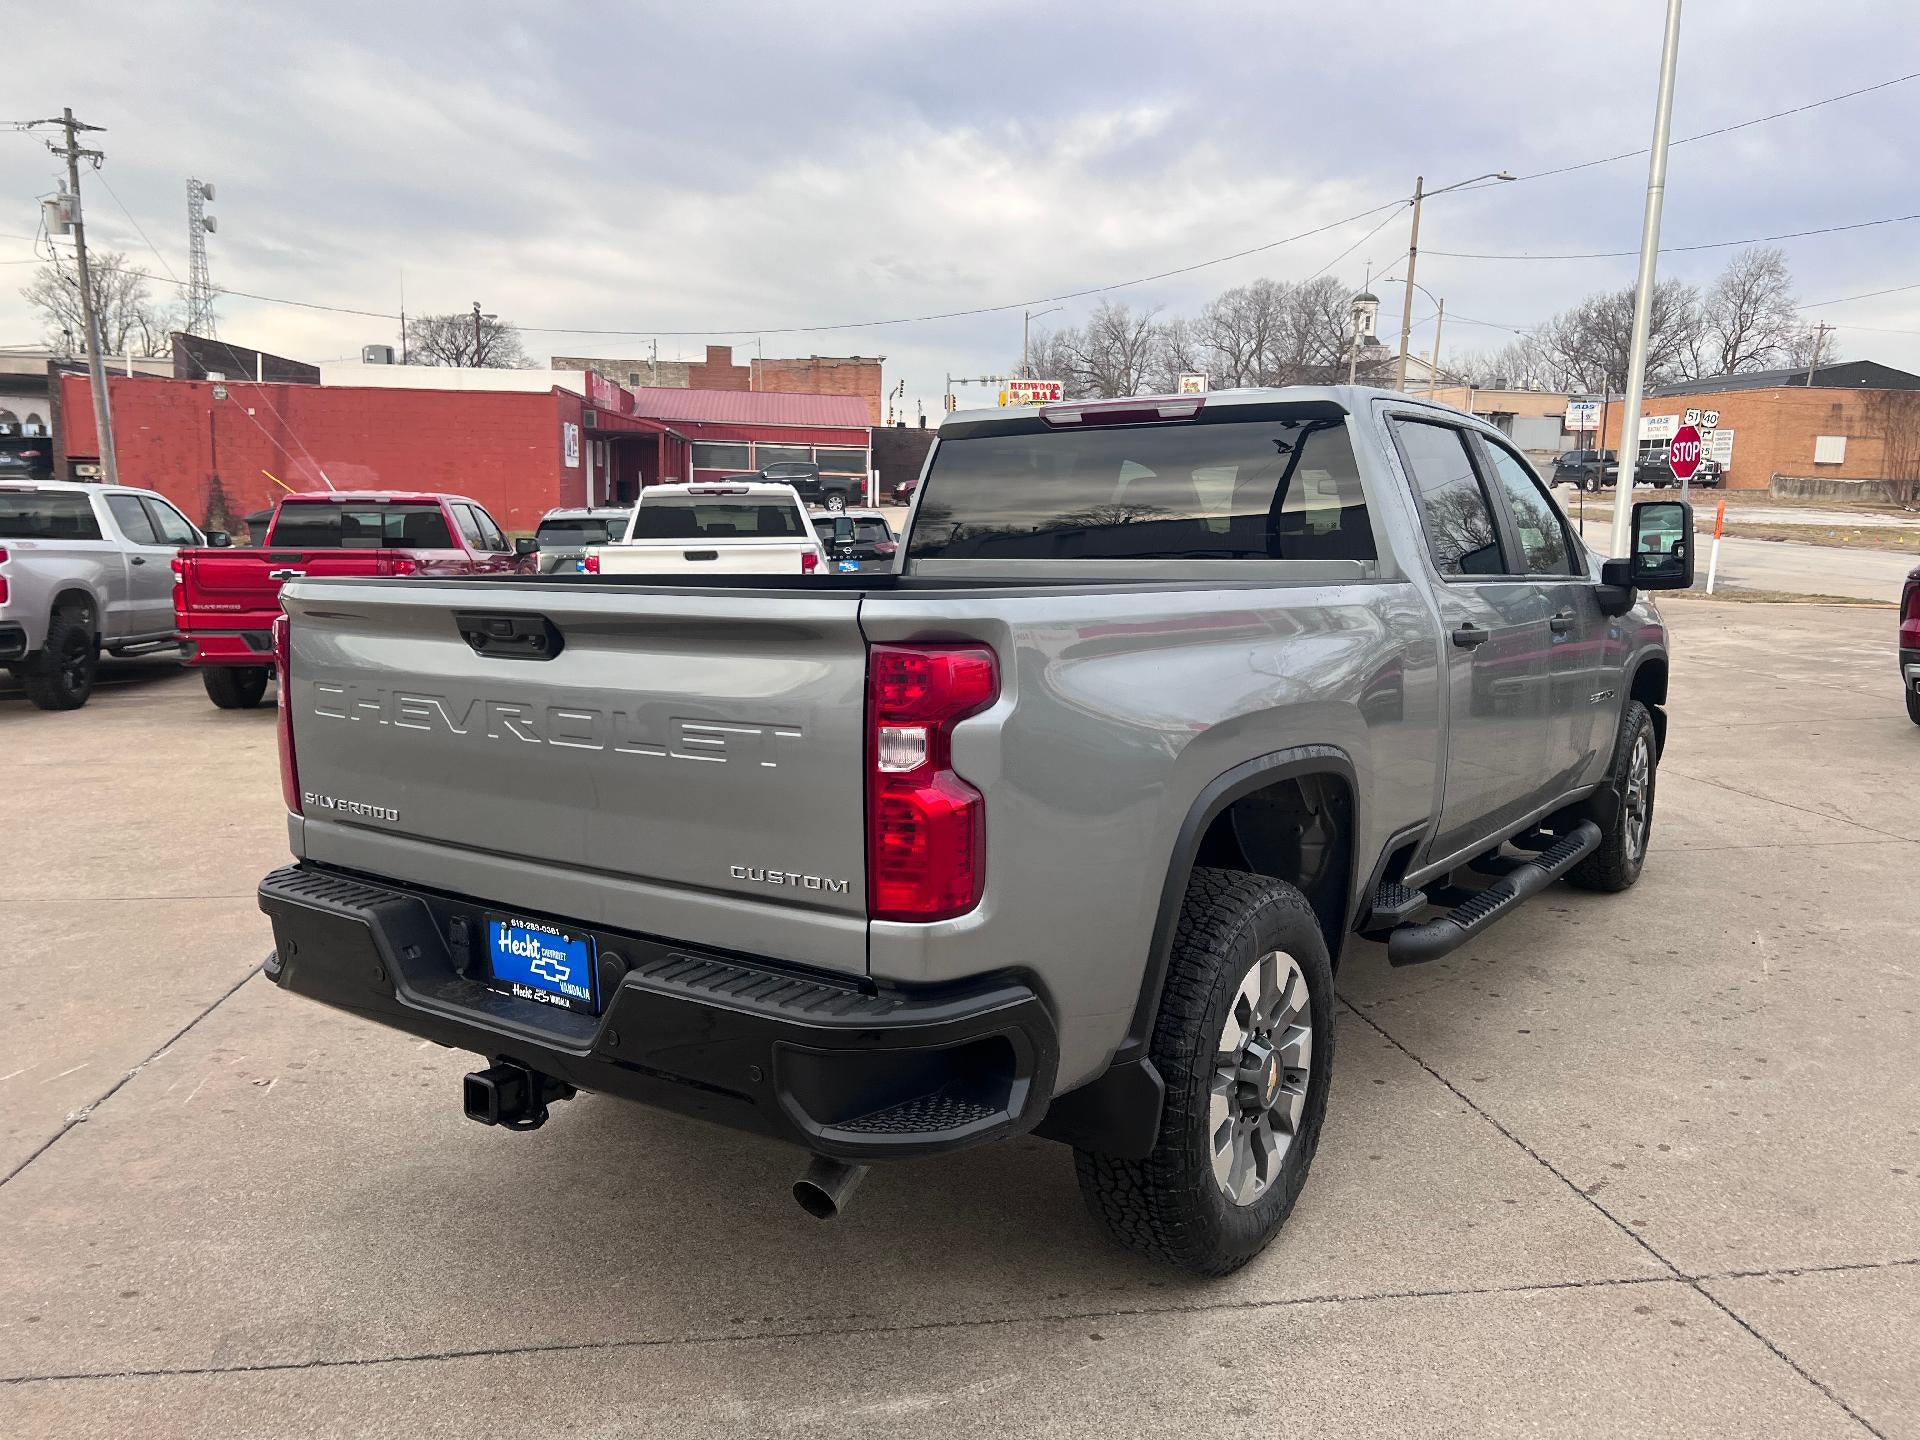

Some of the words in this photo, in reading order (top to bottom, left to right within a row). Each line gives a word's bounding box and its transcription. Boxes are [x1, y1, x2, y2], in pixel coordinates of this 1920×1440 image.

[1031, 391, 1061, 401] BAR
[1650, 417, 1670, 425] ADS
[1688, 411, 1700, 423] 51
[1704, 413, 1718, 425] 40
[1671, 441, 1700, 463] STOP
[312, 680, 804, 769] CHEVROLET
[304, 791, 400, 822] SILVERADO
[729, 865, 850, 895] CUSTOM
[498, 928, 541, 959] Hecht
[512, 983, 533, 1000] Hecht
[559, 981, 591, 1000] VANDALIA
